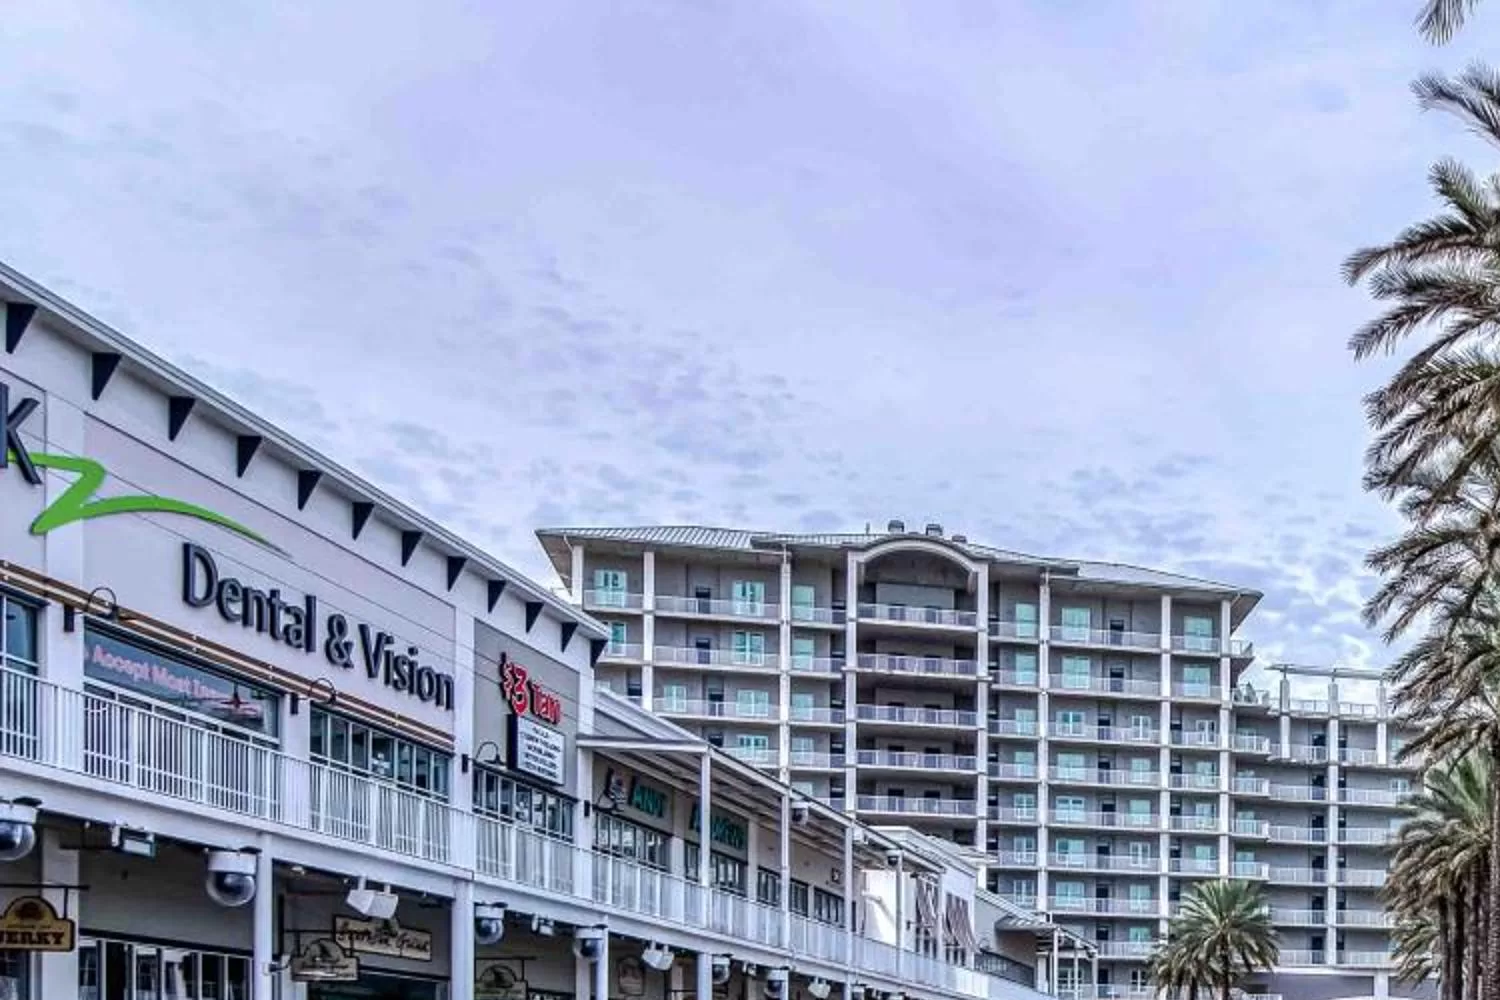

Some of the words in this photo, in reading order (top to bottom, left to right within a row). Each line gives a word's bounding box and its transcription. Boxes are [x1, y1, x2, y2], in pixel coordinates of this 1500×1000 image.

[182, 542, 317, 653] Dental
[325, 613, 354, 669] &
[357, 623, 455, 711] Vision
